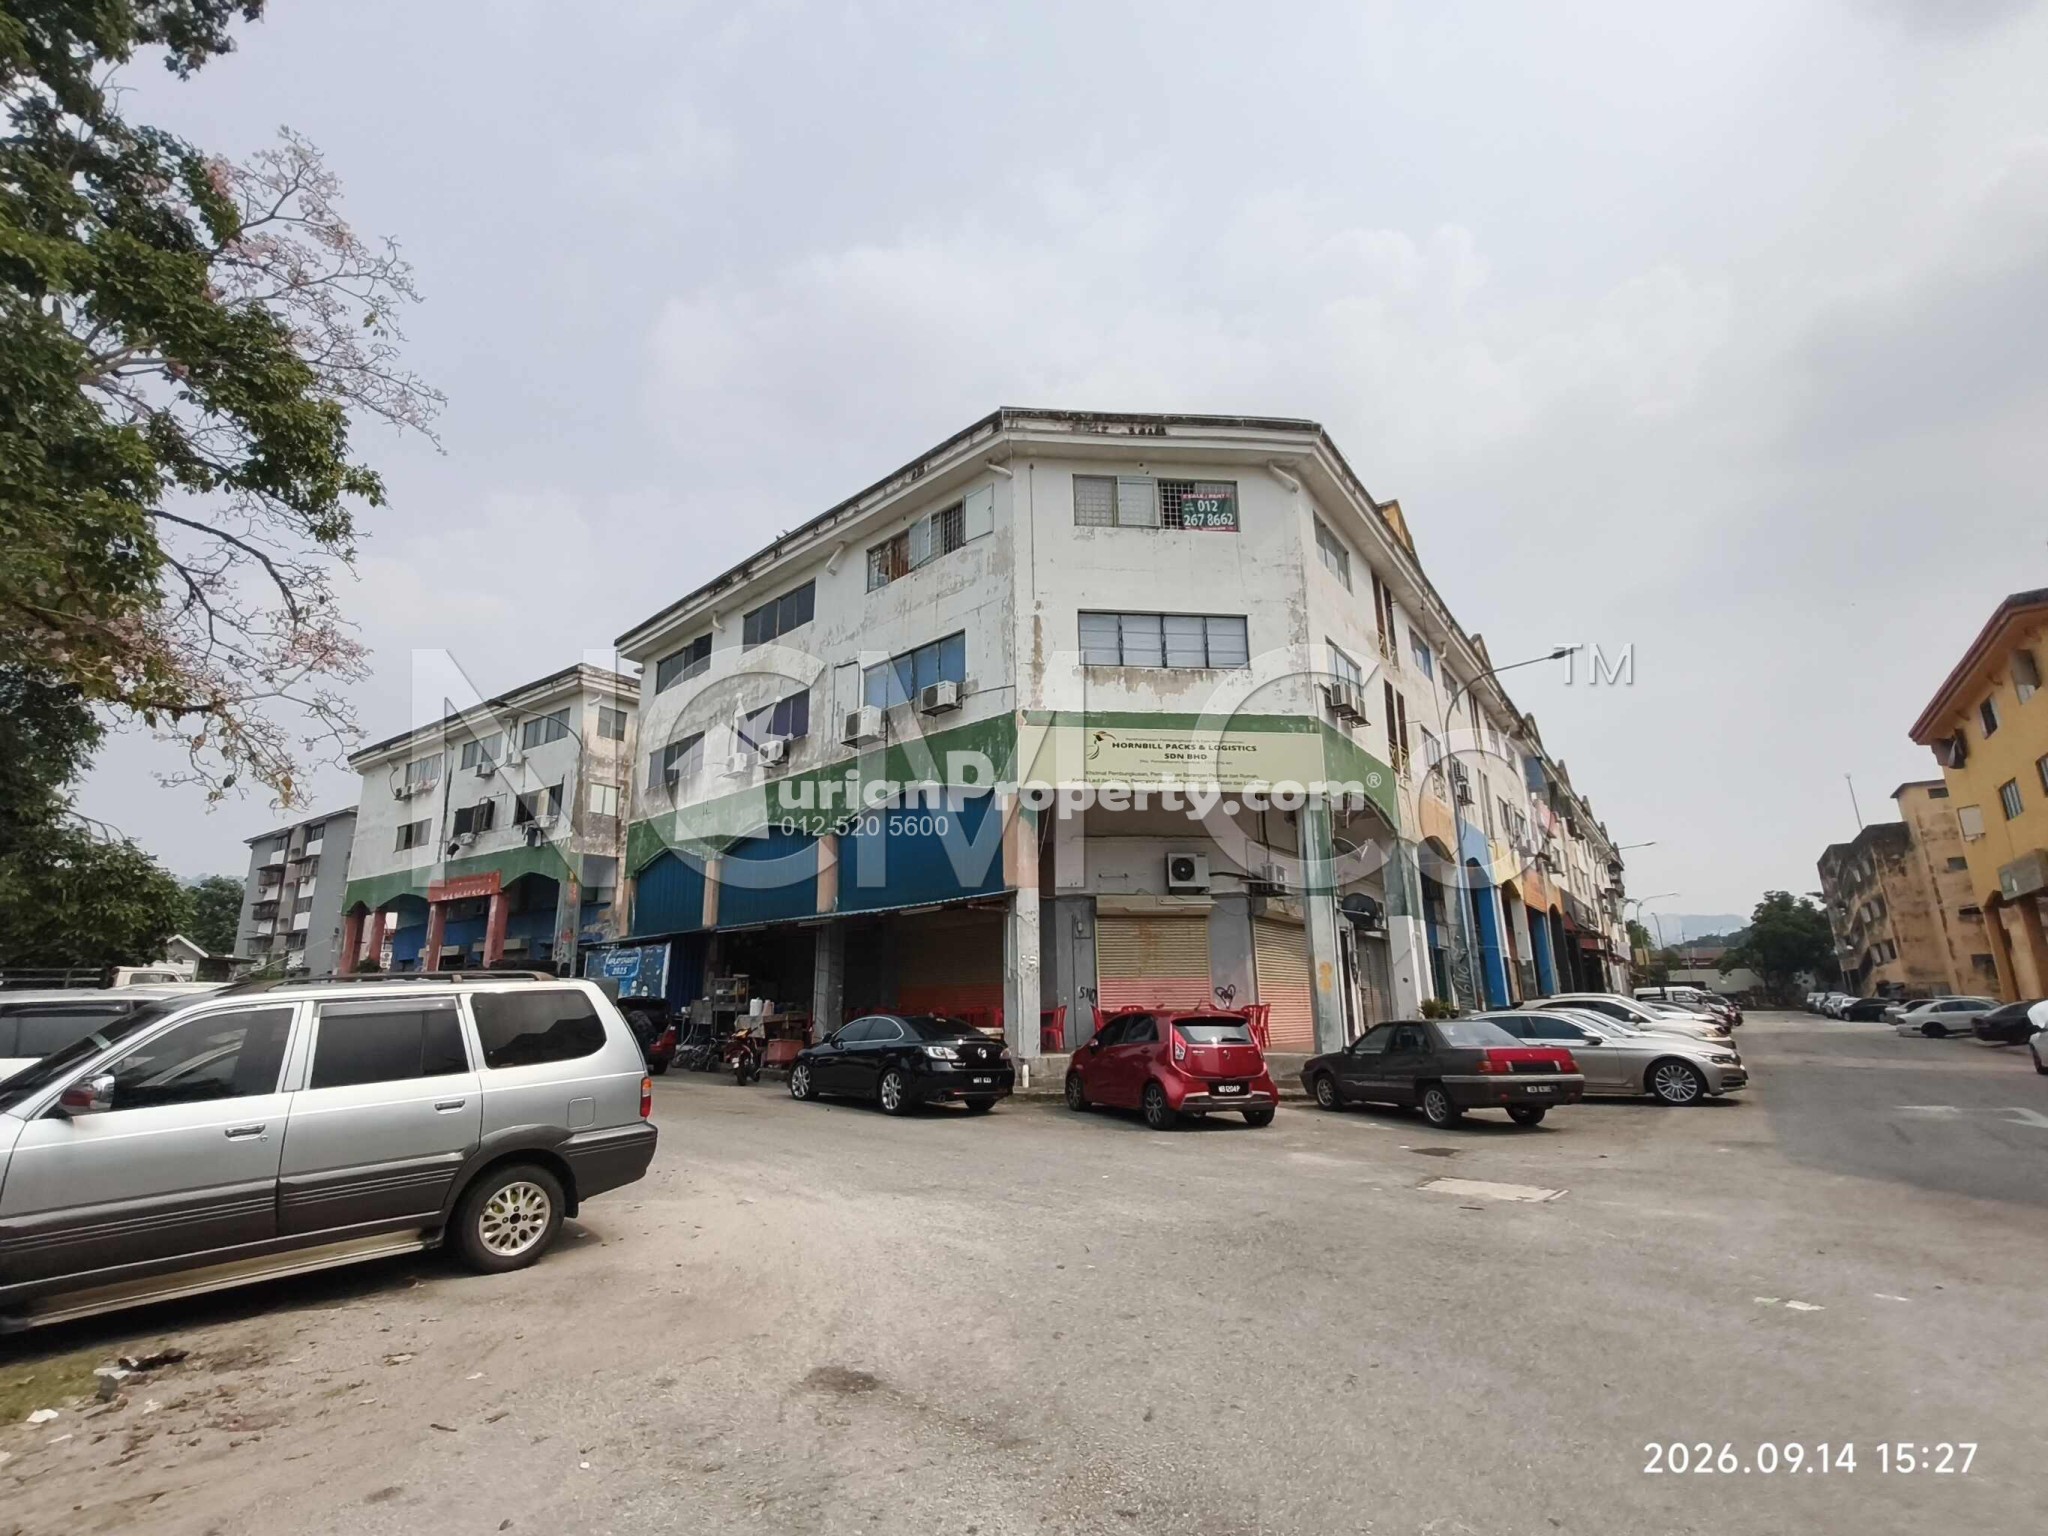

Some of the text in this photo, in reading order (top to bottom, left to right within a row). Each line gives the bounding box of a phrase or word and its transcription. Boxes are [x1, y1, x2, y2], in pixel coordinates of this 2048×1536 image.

[1197, 500, 1218, 512] 012
[1183, 513, 1234, 526] 267 8662
[1112, 742, 1163, 750] HORNBILL
[1165, 743, 1197, 751] PACKS
[1208, 744, 1257, 752] LOGISTICS
